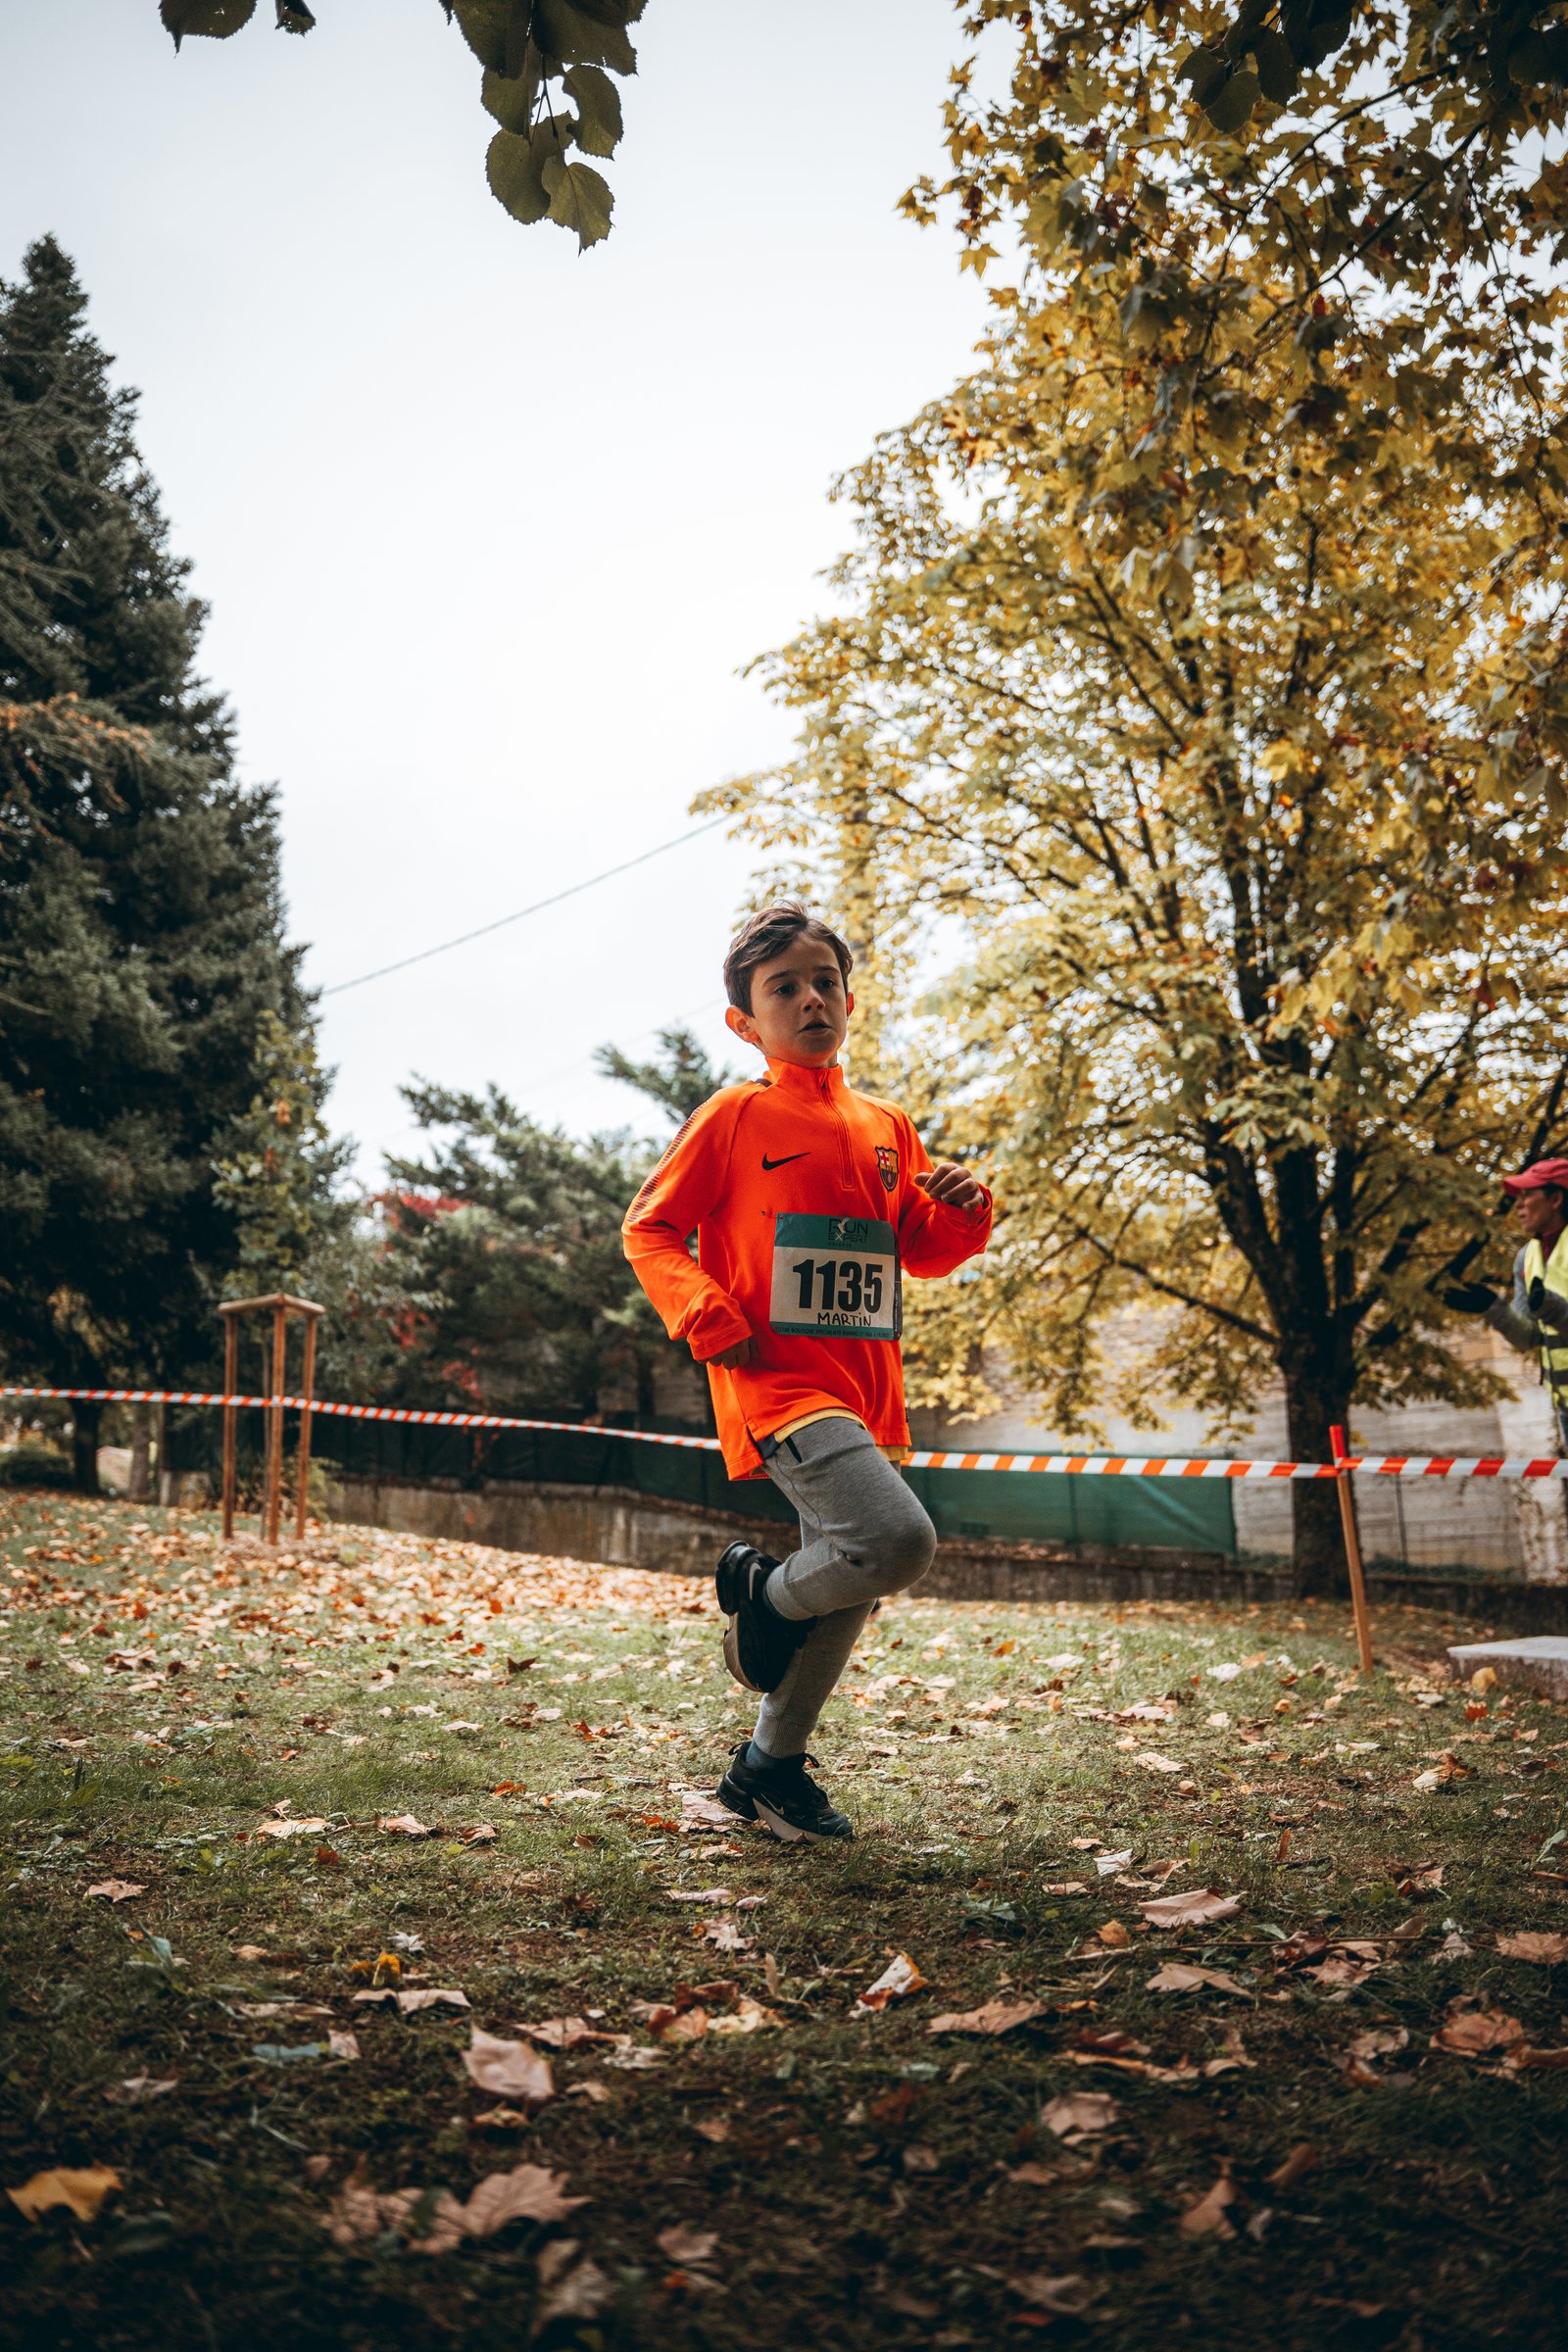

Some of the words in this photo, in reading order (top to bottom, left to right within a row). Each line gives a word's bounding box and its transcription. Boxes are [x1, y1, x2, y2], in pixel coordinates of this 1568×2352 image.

[829, 1218, 868, 1234] RUN
[828, 1233, 869, 1243] EXPERT
[793, 1259, 883, 1313] 1135
